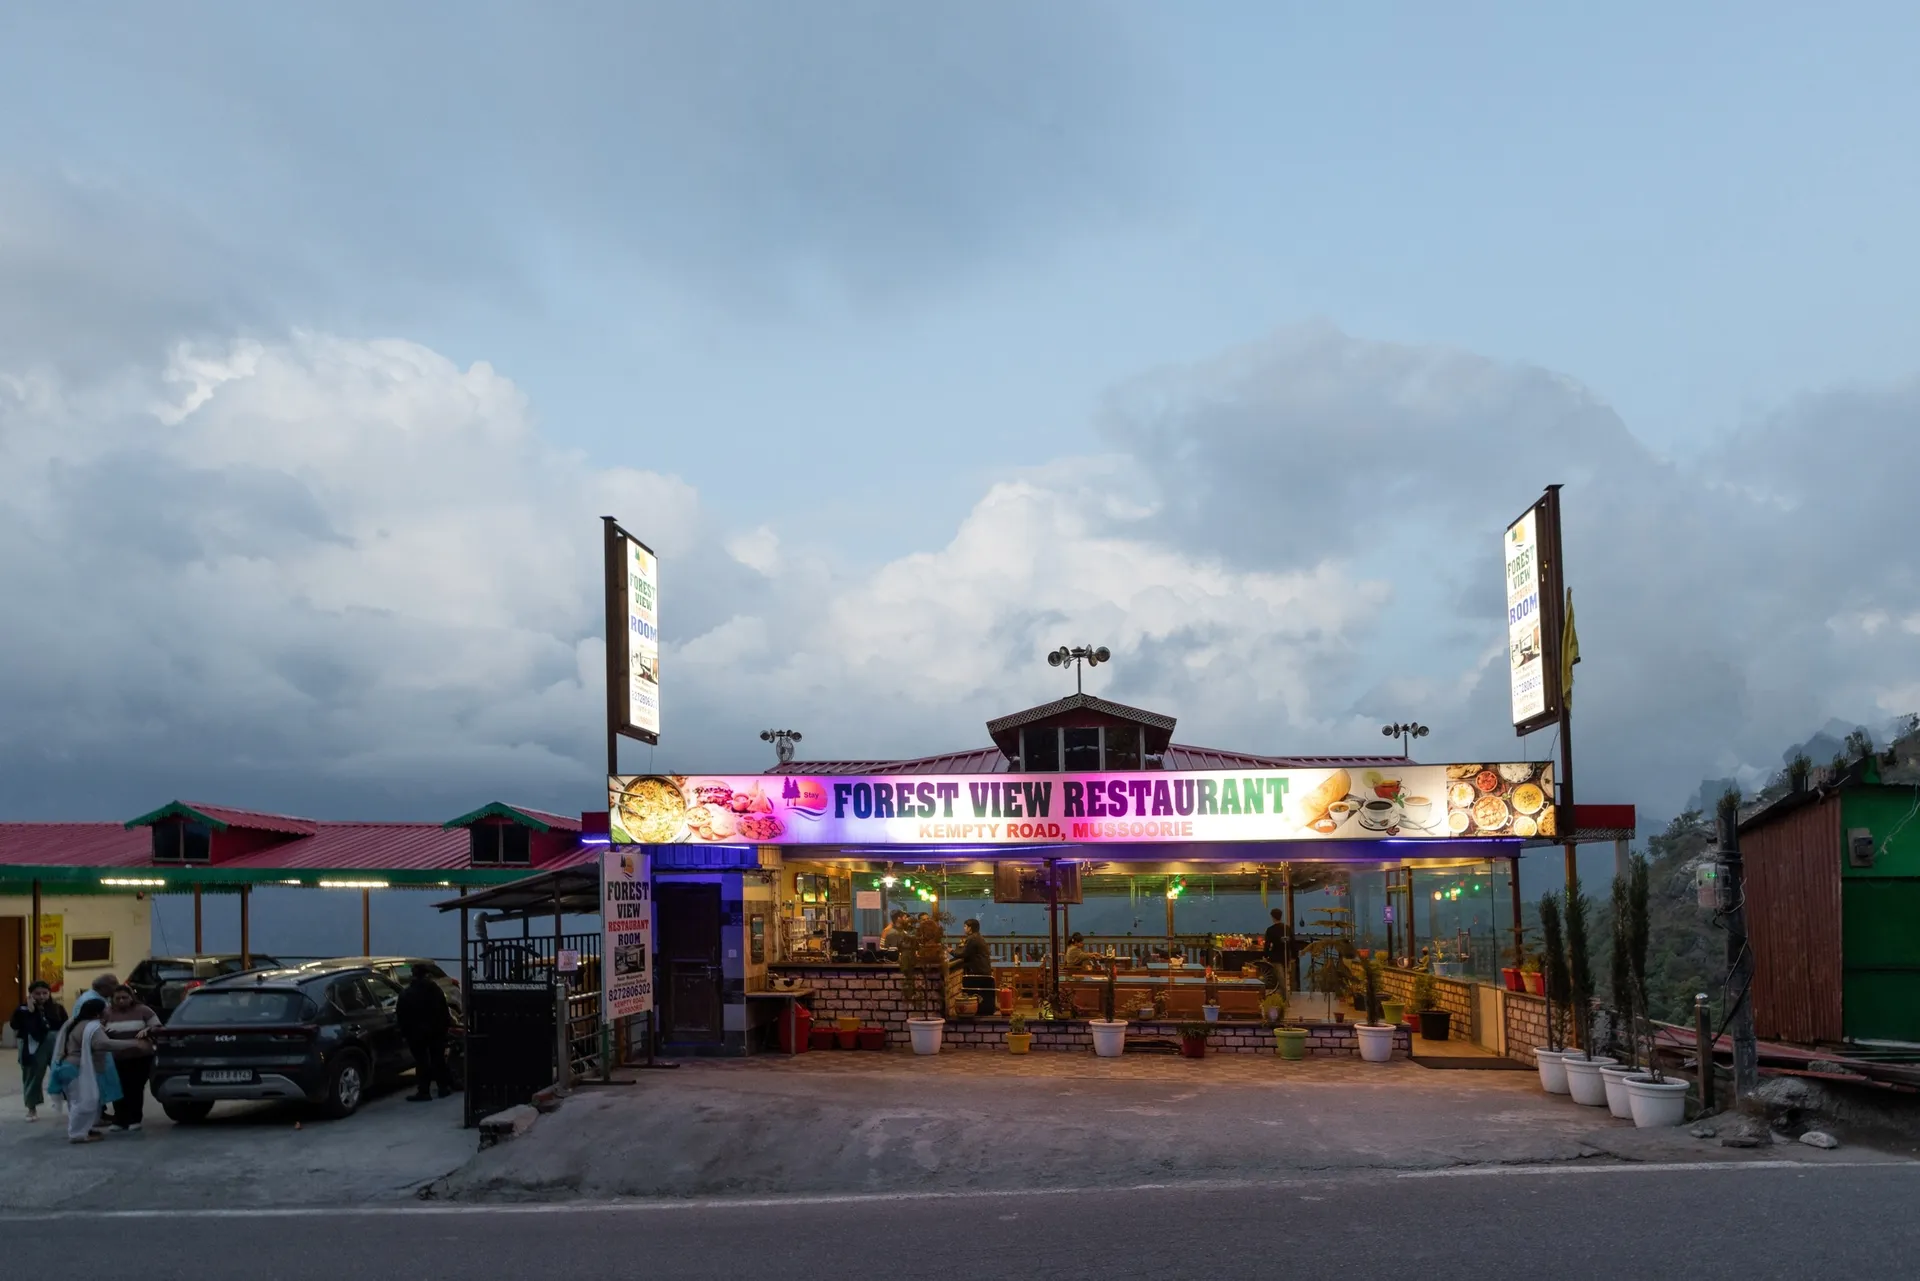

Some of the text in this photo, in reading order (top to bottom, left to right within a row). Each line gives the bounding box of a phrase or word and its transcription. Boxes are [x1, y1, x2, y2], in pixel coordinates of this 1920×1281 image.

[1507, 544, 1535, 578] FOREST
[629, 572, 656, 600] FOREST
[1512, 565, 1531, 589] VIEW
[634, 592, 653, 612] VIEW
[1509, 592, 1538, 626] ROOM
[630, 614, 658, 643] ROOM
[803, 792, 819, 800] Stay
[833, 777, 1290, 819] FOREST VIEW RESTAURANT
[919, 821, 1193, 841] KEMPTY ROAD, MUSSOORIE
[607, 881, 649, 901] FOREST
[617, 903, 640, 919] VIEW
[608, 919, 649, 932] RESTAURANT
[618, 932, 640, 946] ROOM
[608, 983, 651, 1002] 8272806302
